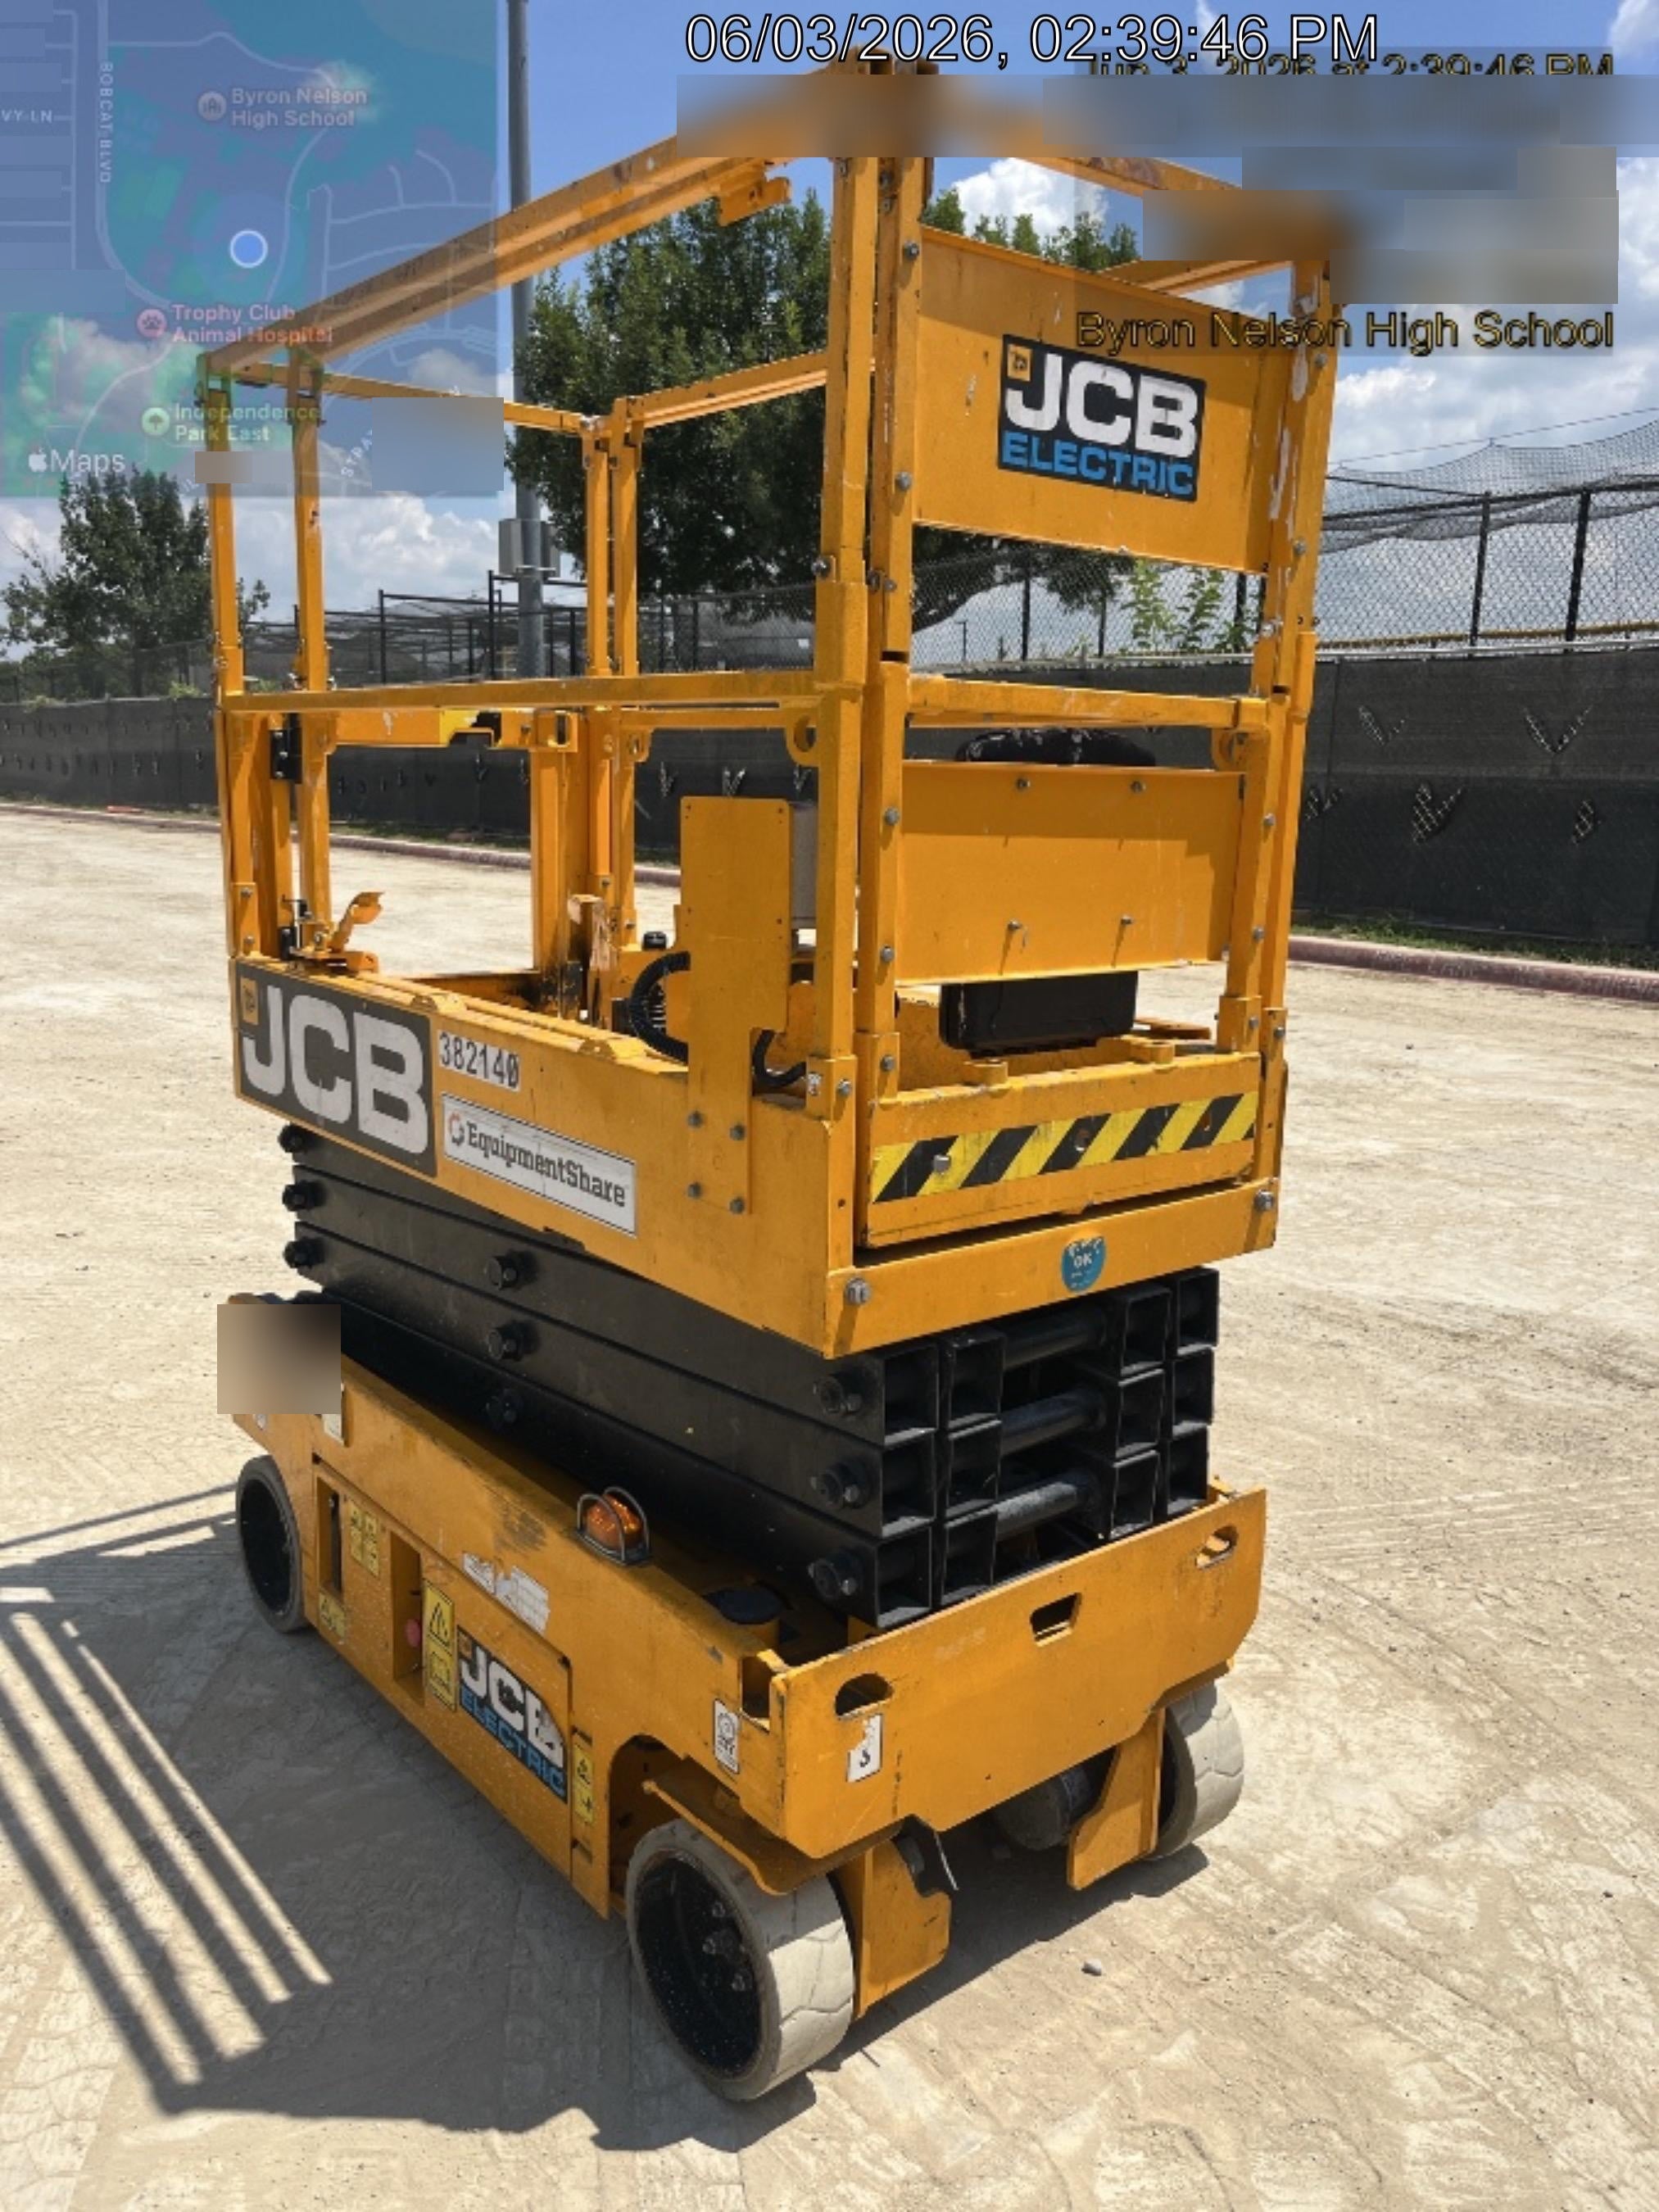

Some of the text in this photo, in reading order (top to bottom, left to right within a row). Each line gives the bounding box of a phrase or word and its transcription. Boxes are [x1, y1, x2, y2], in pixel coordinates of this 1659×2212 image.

[1005, 353, 1199, 458] JCB
[1002, 430, 1194, 496] ELECTRIC
[243, 985, 428, 1154] JCB
[439, 1031, 520, 1090] 382140
[466, 1120, 626, 1208] EquipmentShare
[460, 1645, 564, 1769] JCB
[461, 1683, 566, 1798] ELECTRIC
